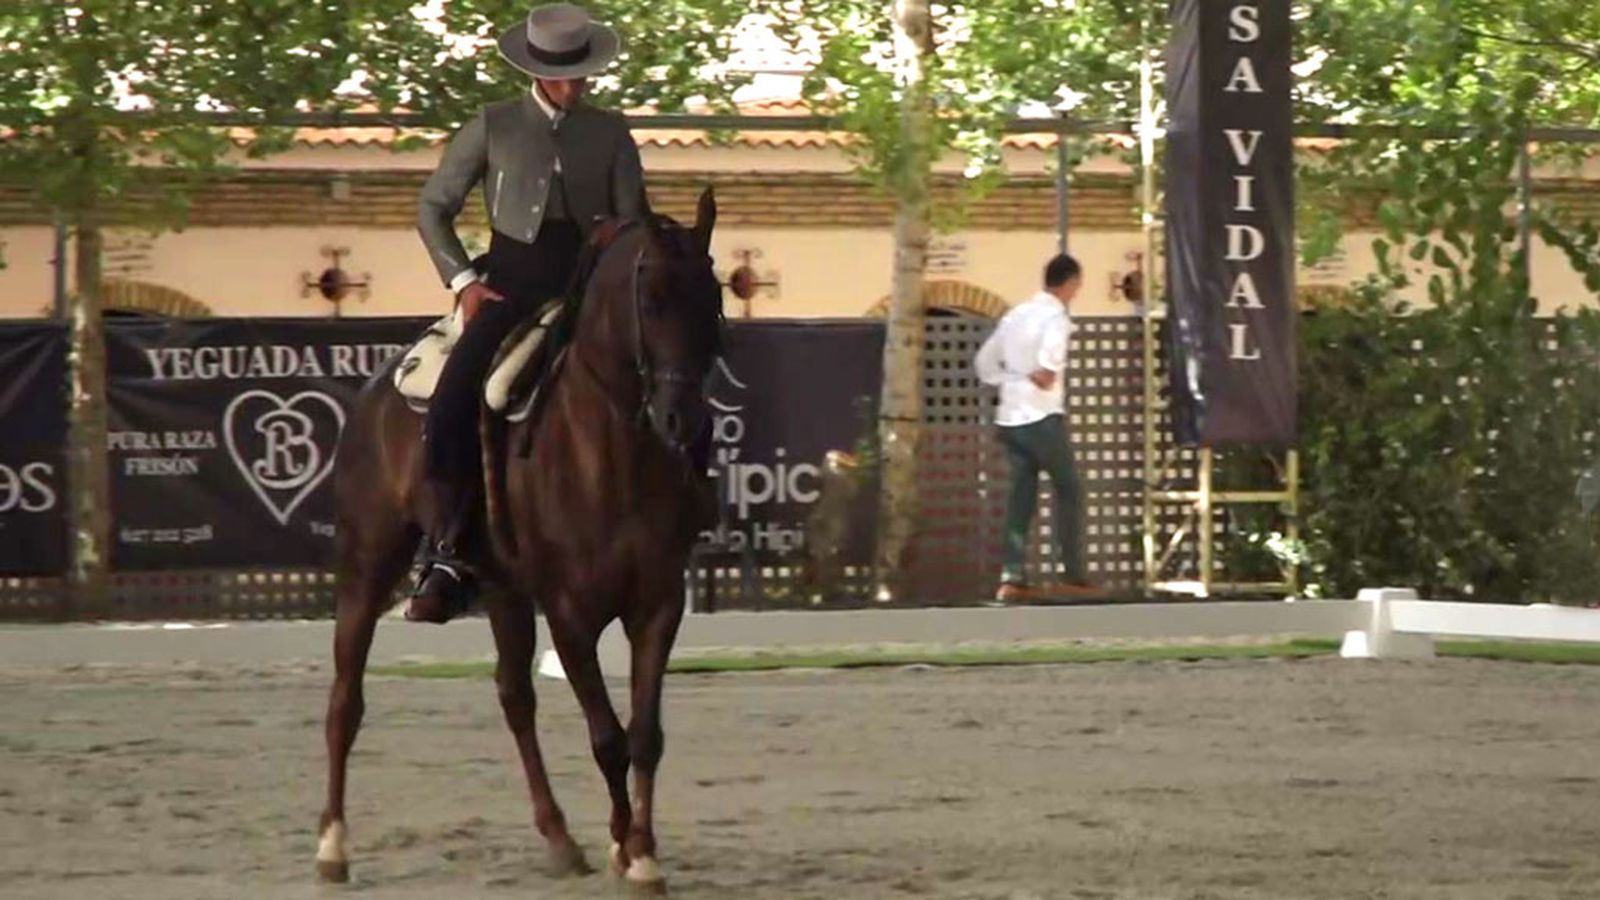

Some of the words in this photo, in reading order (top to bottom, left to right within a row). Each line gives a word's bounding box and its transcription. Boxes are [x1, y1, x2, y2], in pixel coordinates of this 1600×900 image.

[1223, 5, 1264, 93] SA
[1223, 129, 1266, 361] VIDAL
[147, 344, 325, 381] YEGUADA
[107, 430, 161, 451] PURA
[164, 430, 217, 449] RAZA
[125, 453, 199, 476] FRISÓN
